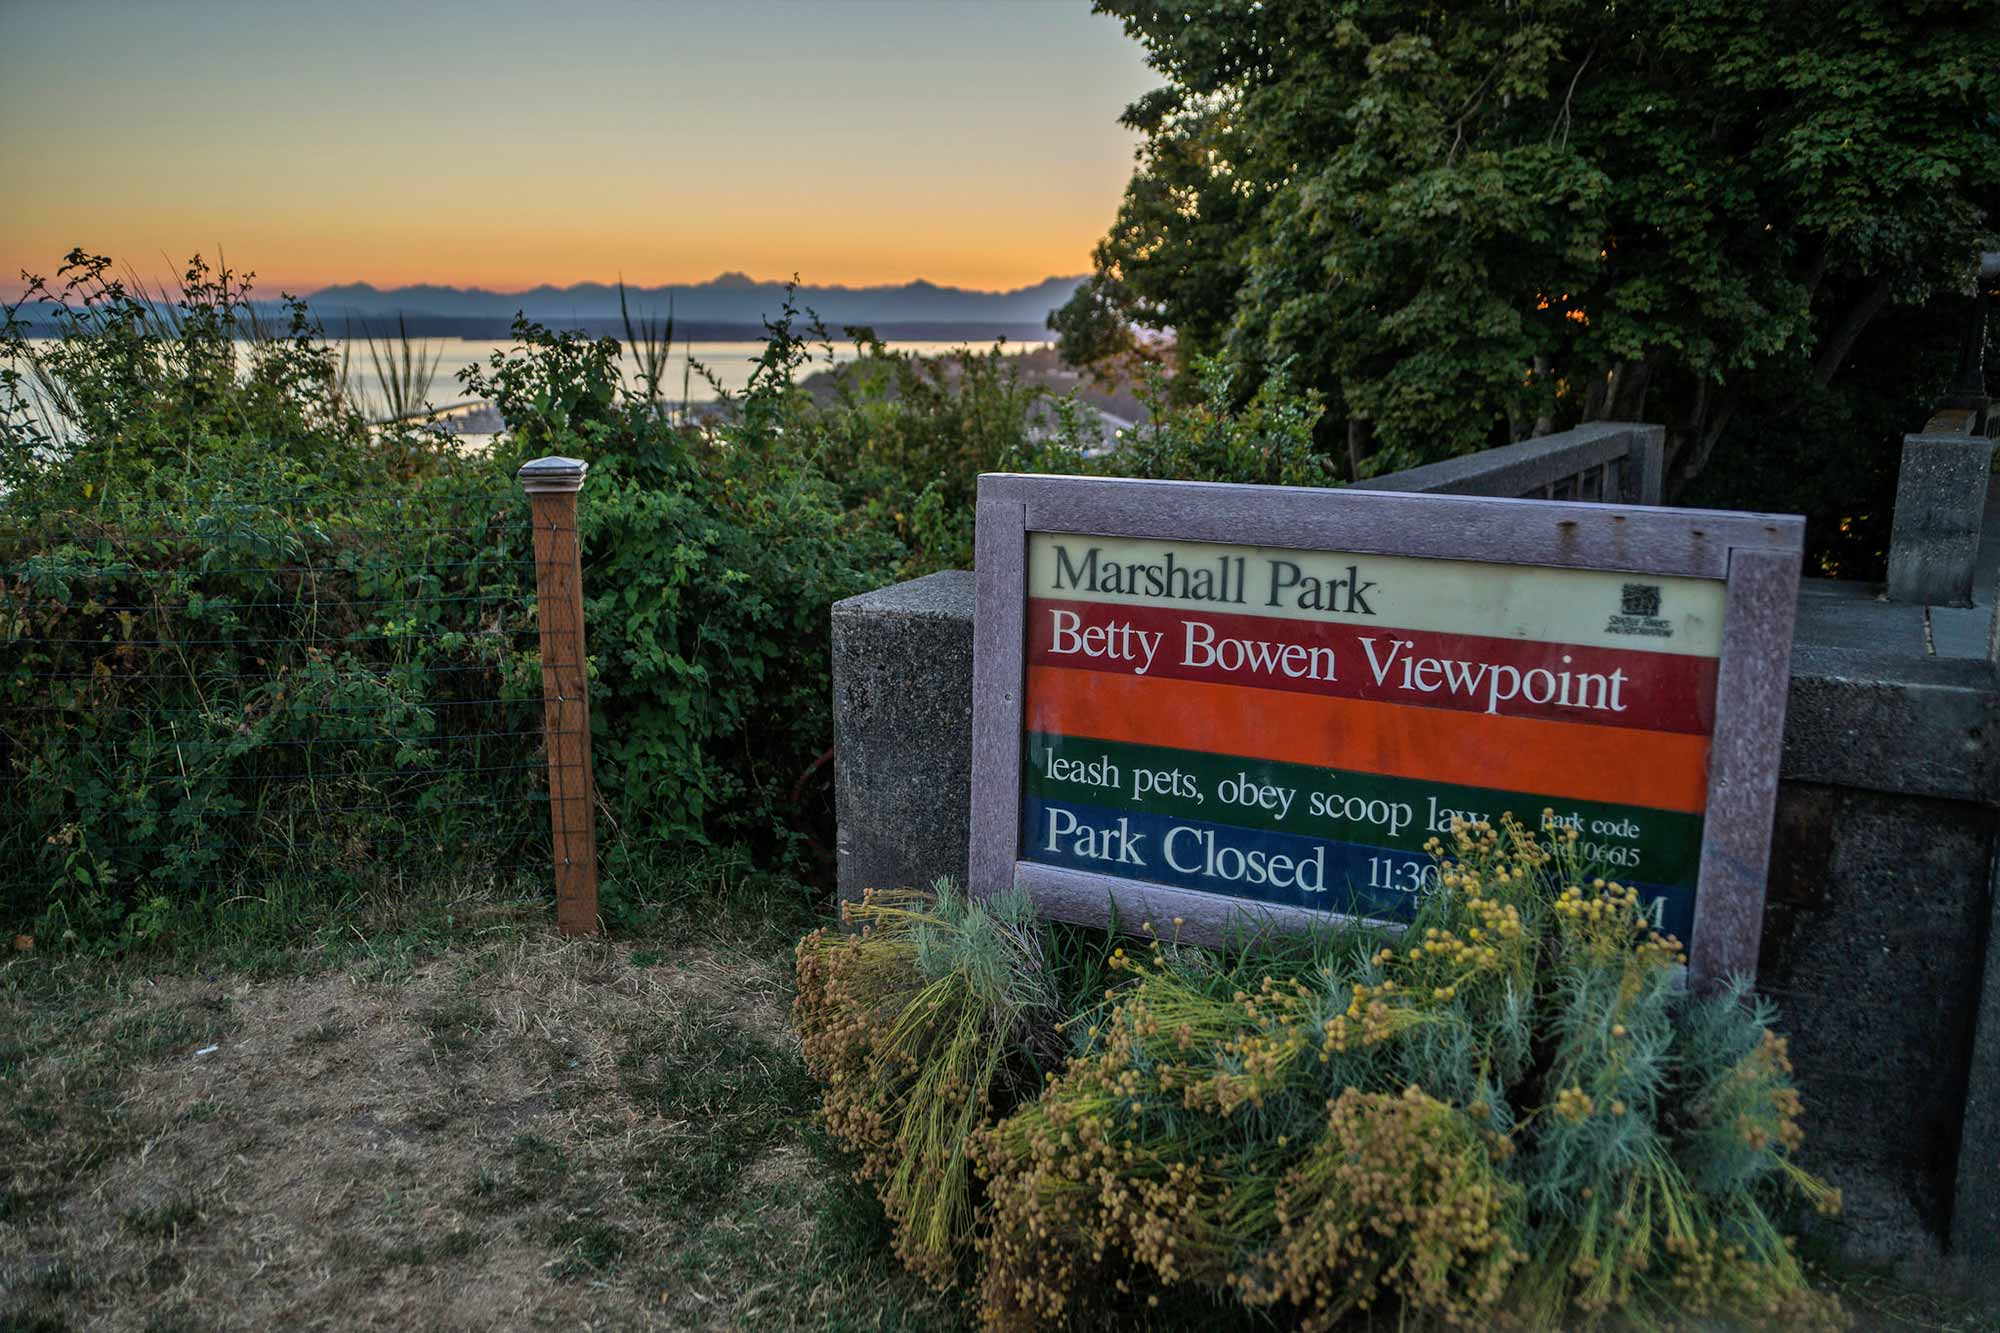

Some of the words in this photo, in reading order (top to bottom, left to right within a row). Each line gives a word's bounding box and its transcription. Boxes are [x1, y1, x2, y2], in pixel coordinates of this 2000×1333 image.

[1052, 545, 1246, 604] Marshall
[1264, 560, 1377, 615] Park
[1048, 609, 1164, 675] Betty
[1180, 620, 1338, 682] Bowen
[1357, 636, 1629, 714] Viewpoint
[1043, 748, 1121, 788] leash
[1131, 765, 1205, 805] pets,
[1217, 772, 1297, 820] obey
[1309, 791, 1413, 837] scoop
[1591, 818, 1641, 838] code
[1043, 807, 1147, 866] Park
[1163, 826, 1328, 893] Closed
[1367, 856, 1441, 895] 11:30
